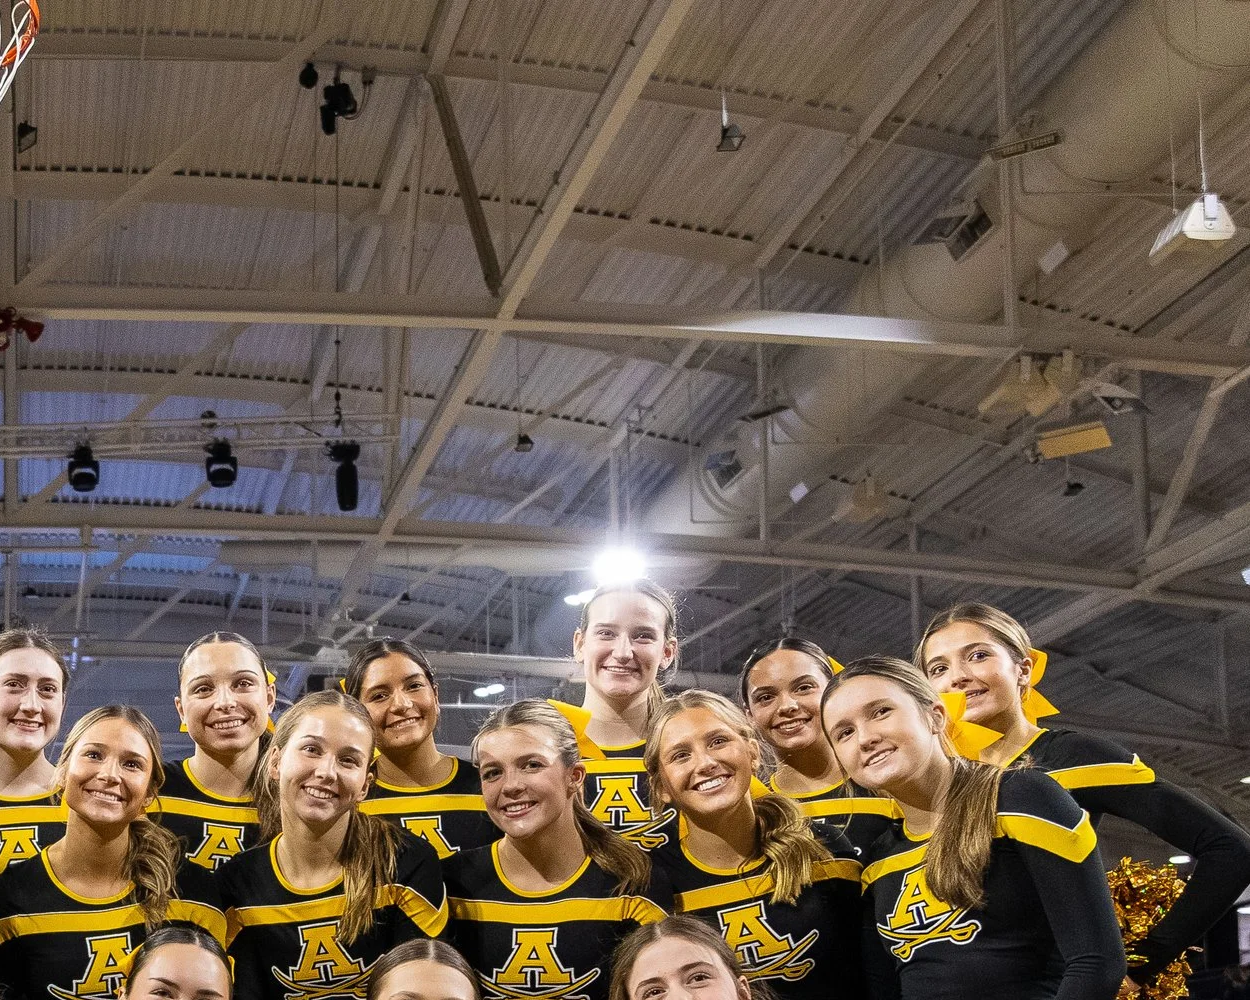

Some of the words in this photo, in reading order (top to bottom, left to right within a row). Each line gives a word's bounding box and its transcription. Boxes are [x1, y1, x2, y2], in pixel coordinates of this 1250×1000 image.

[589, 775, 651, 825] A
[186, 822, 244, 871] A
[887, 866, 953, 931] A
[289, 921, 365, 983] A
[493, 927, 576, 988] A
[717, 901, 795, 964] A
[73, 932, 132, 997] A
